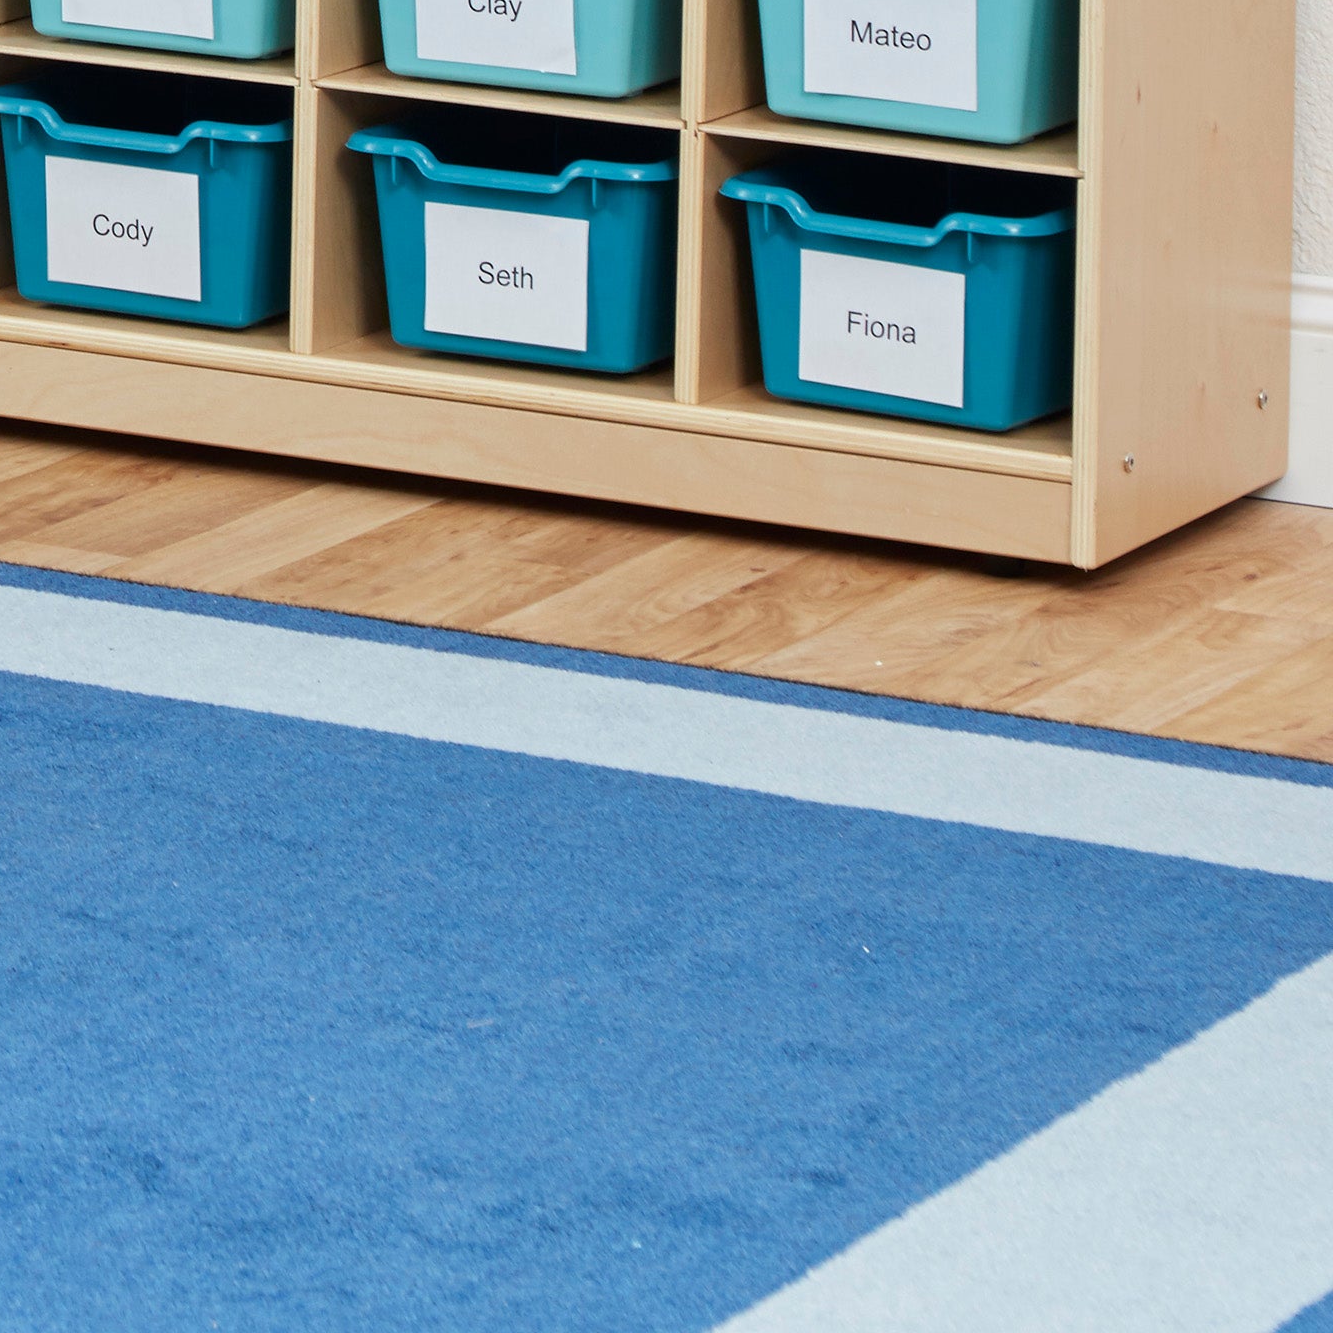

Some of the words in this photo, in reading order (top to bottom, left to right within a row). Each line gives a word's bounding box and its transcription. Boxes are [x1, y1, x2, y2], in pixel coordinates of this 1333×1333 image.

[851, 19, 932, 52] Mateo
[92, 213, 154, 248] Cody
[478, 261, 534, 290] Seth
[847, 310, 916, 345] Fiona
